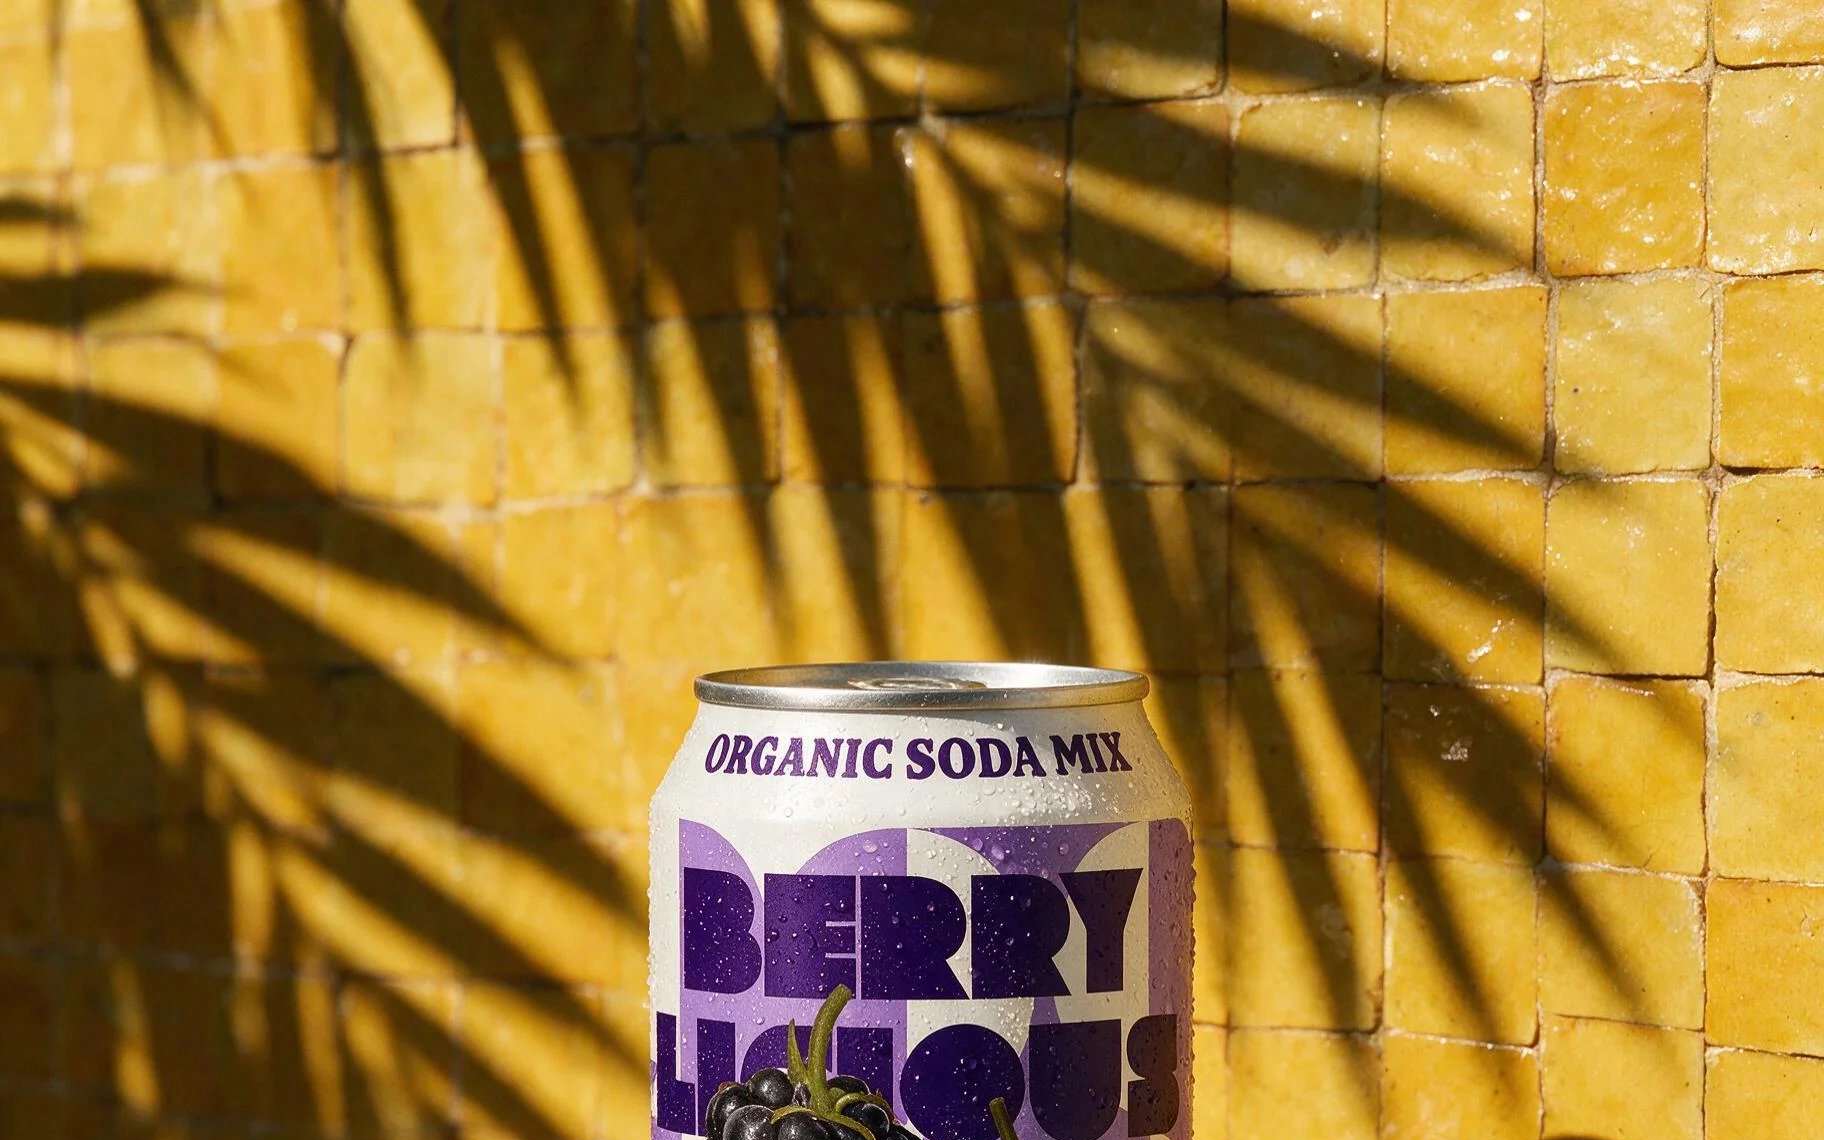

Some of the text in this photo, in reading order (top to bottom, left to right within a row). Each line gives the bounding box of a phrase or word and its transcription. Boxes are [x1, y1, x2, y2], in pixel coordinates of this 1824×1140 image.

[705, 731, 1133, 779] ORGANIC SODA MIX
[684, 867, 1144, 1000] BERRY
